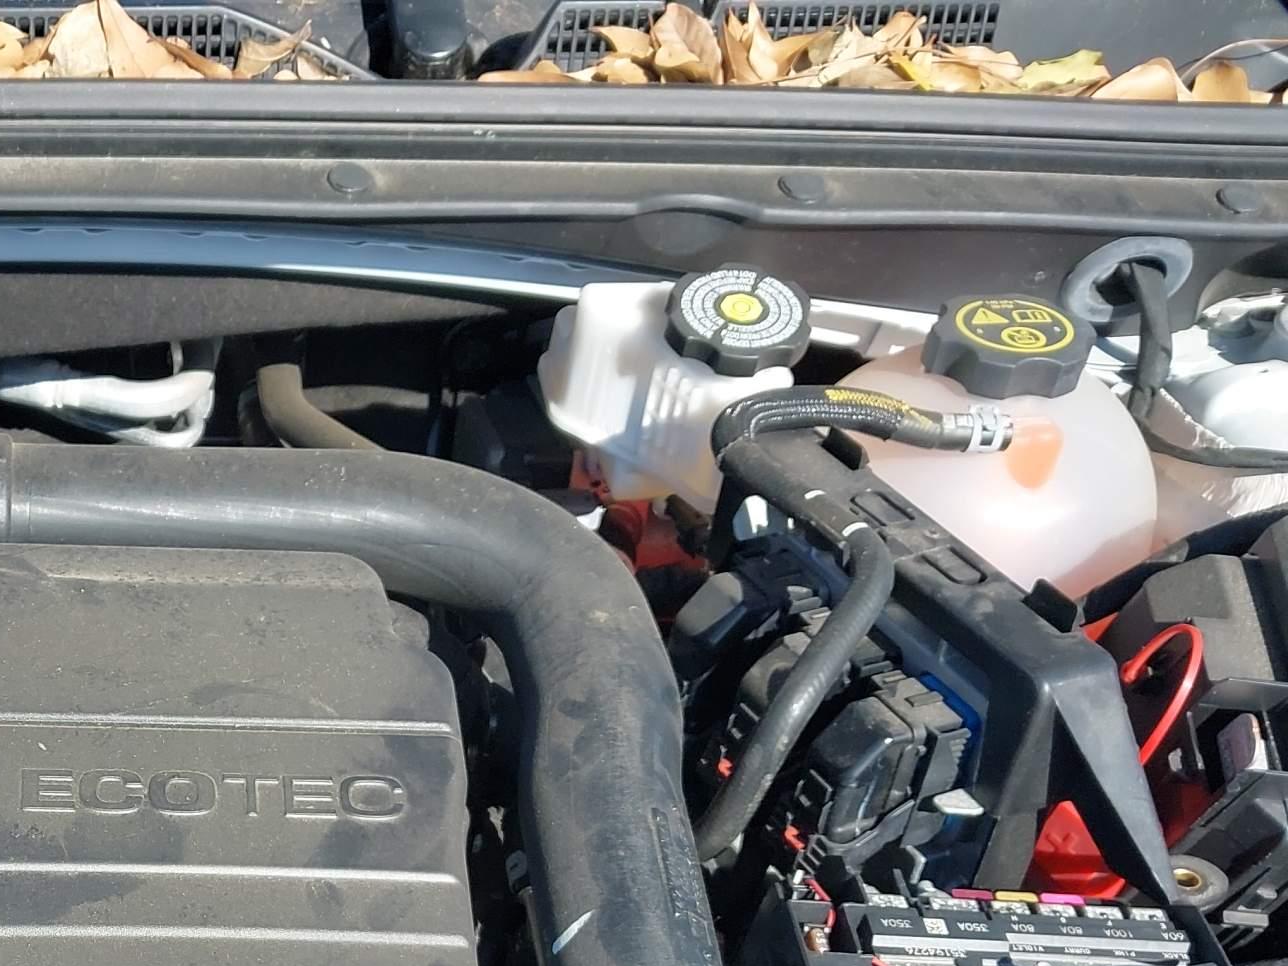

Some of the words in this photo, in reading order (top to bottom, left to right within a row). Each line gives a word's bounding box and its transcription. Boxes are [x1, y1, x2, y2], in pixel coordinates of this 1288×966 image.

[20, 768, 407, 821] ECOTEC
[880, 918, 913, 929] 350A
[956, 921, 990, 933] 350A
[1161, 931, 1185, 941] 60A
